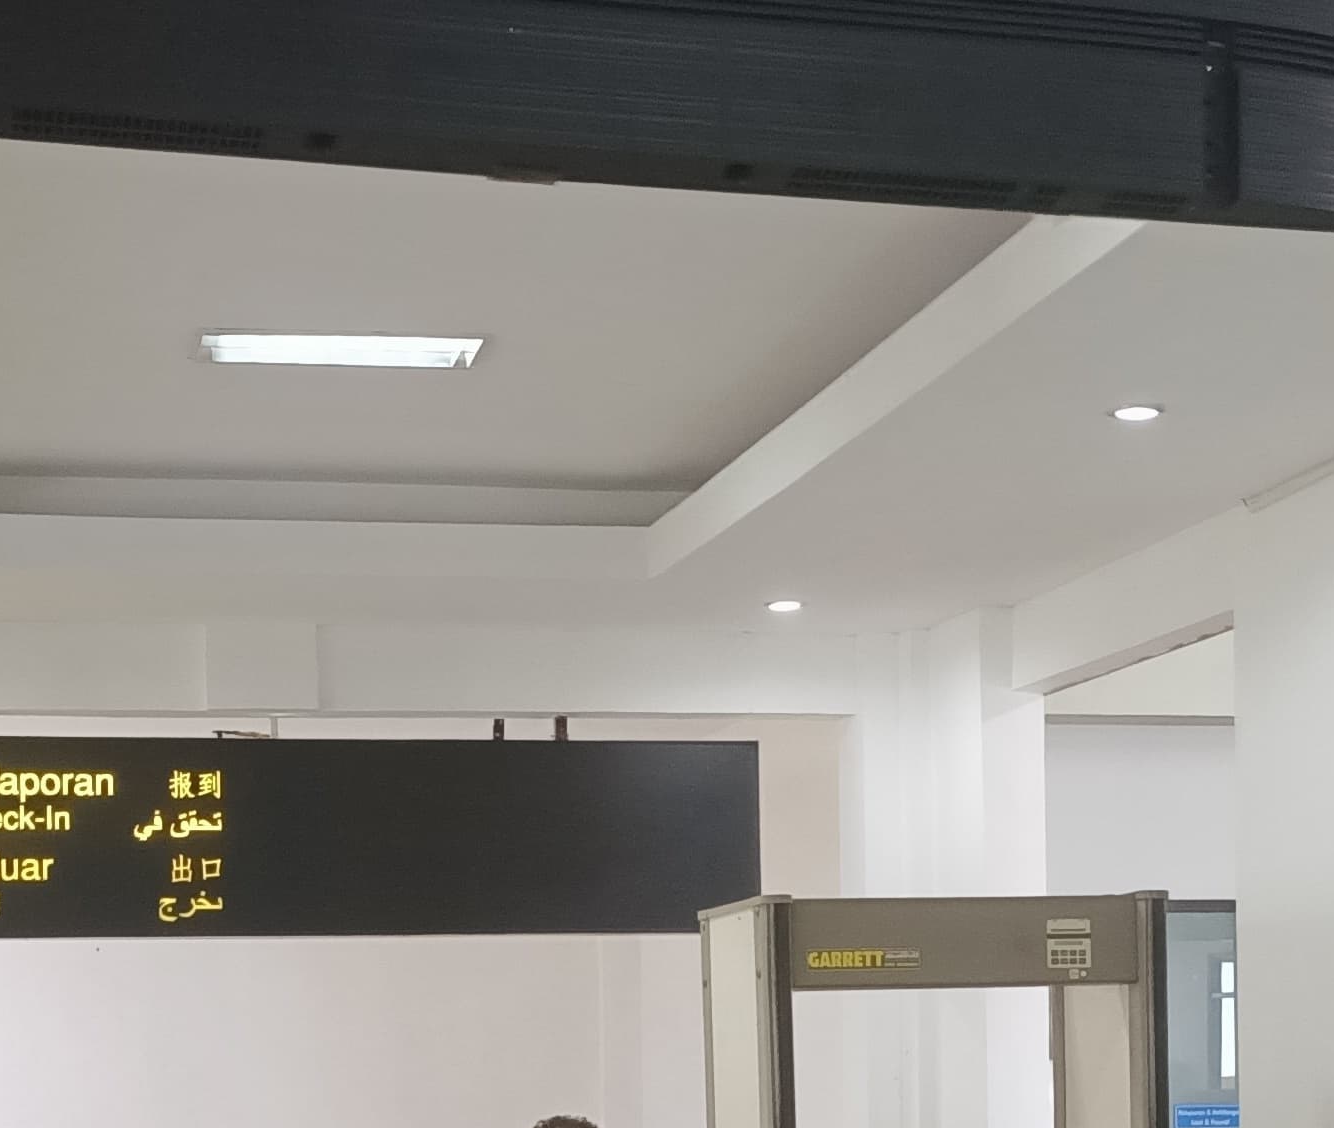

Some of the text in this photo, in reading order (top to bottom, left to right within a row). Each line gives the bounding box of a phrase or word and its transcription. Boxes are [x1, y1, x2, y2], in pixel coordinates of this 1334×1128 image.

[168, 770, 221, 799] 报到
[133, 809, 164, 841] في
[170, 854, 221, 883] 出口
[808, 950, 884, 968] GARRETT
